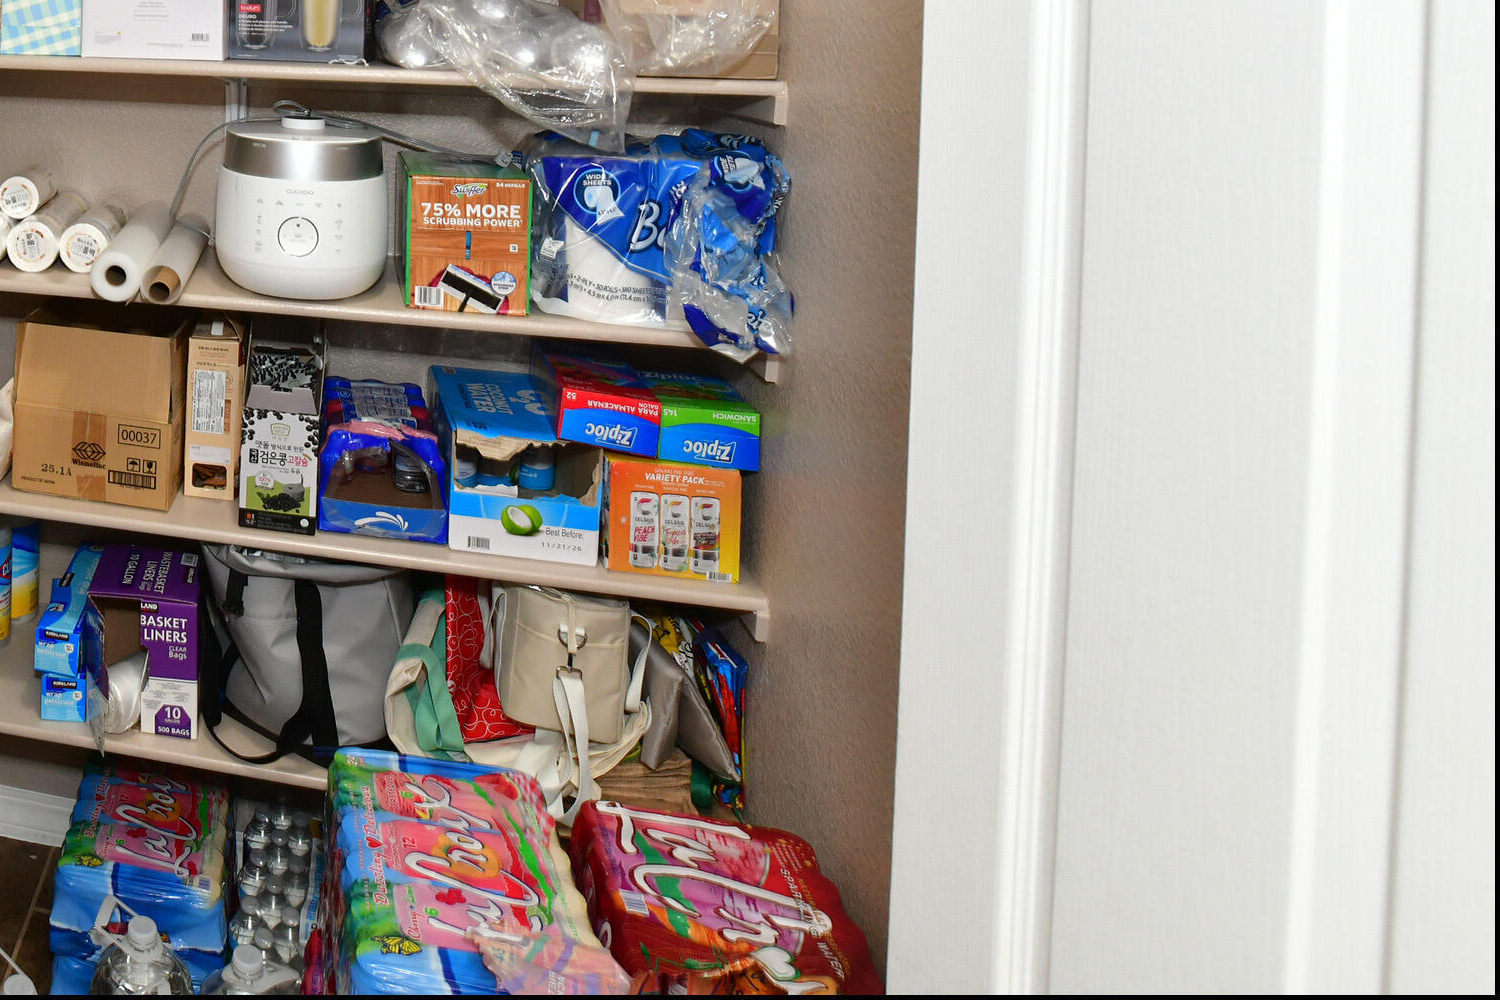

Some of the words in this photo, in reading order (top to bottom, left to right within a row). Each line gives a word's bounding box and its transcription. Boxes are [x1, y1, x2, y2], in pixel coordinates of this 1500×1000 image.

[451, 183, 487, 197] Swiffer
[421, 202, 461, 217] 75%
[465, 203, 521, 219] MORE
[423, 216, 481, 227] SCRUBBING
[466, 382, 494, 414] WATER
[484, 382, 513, 416] COCONUT
[566, 391, 576, 400] 52
[587, 399, 635, 413] ALMACENAR
[637, 406, 659, 416] PARA
[662, 407, 678, 417] 145
[121, 429, 158, 445] 00037
[585, 423, 634, 446] Ziploc
[259, 450, 287, 466] 검은콩
[683, 439, 733, 463] Ziploc
[41, 462, 72, 477] 25.1A
[645, 473, 682, 482] VARIETY
[682, 475, 705, 484] PACK
[545, 527, 560, 537] Best
[561, 529, 583, 539] Before
[634, 526, 655, 534] PEACH
[634, 534, 648, 543] VIBE
[541, 541, 582, 552] 11/21/26
[131, 553, 139, 562] 10
[122, 563, 138, 586] GALLON
[143, 560, 157, 581] LINERS
[153, 551, 173, 595] WASTEBASKET
[140, 614, 187, 630] BASKET
[144, 628, 187, 643] LINERS
[168, 651, 187, 660] Bags
[165, 707, 181, 718] 10
[158, 725, 170, 733] 500
[171, 726, 190, 736] BAGS
[363, 786, 377, 835] Delicious
[402, 836, 417, 848] 12
[368, 849, 389, 905] Dazzling
[425, 907, 438, 916] 6
[407, 911, 421, 940] Cherry
